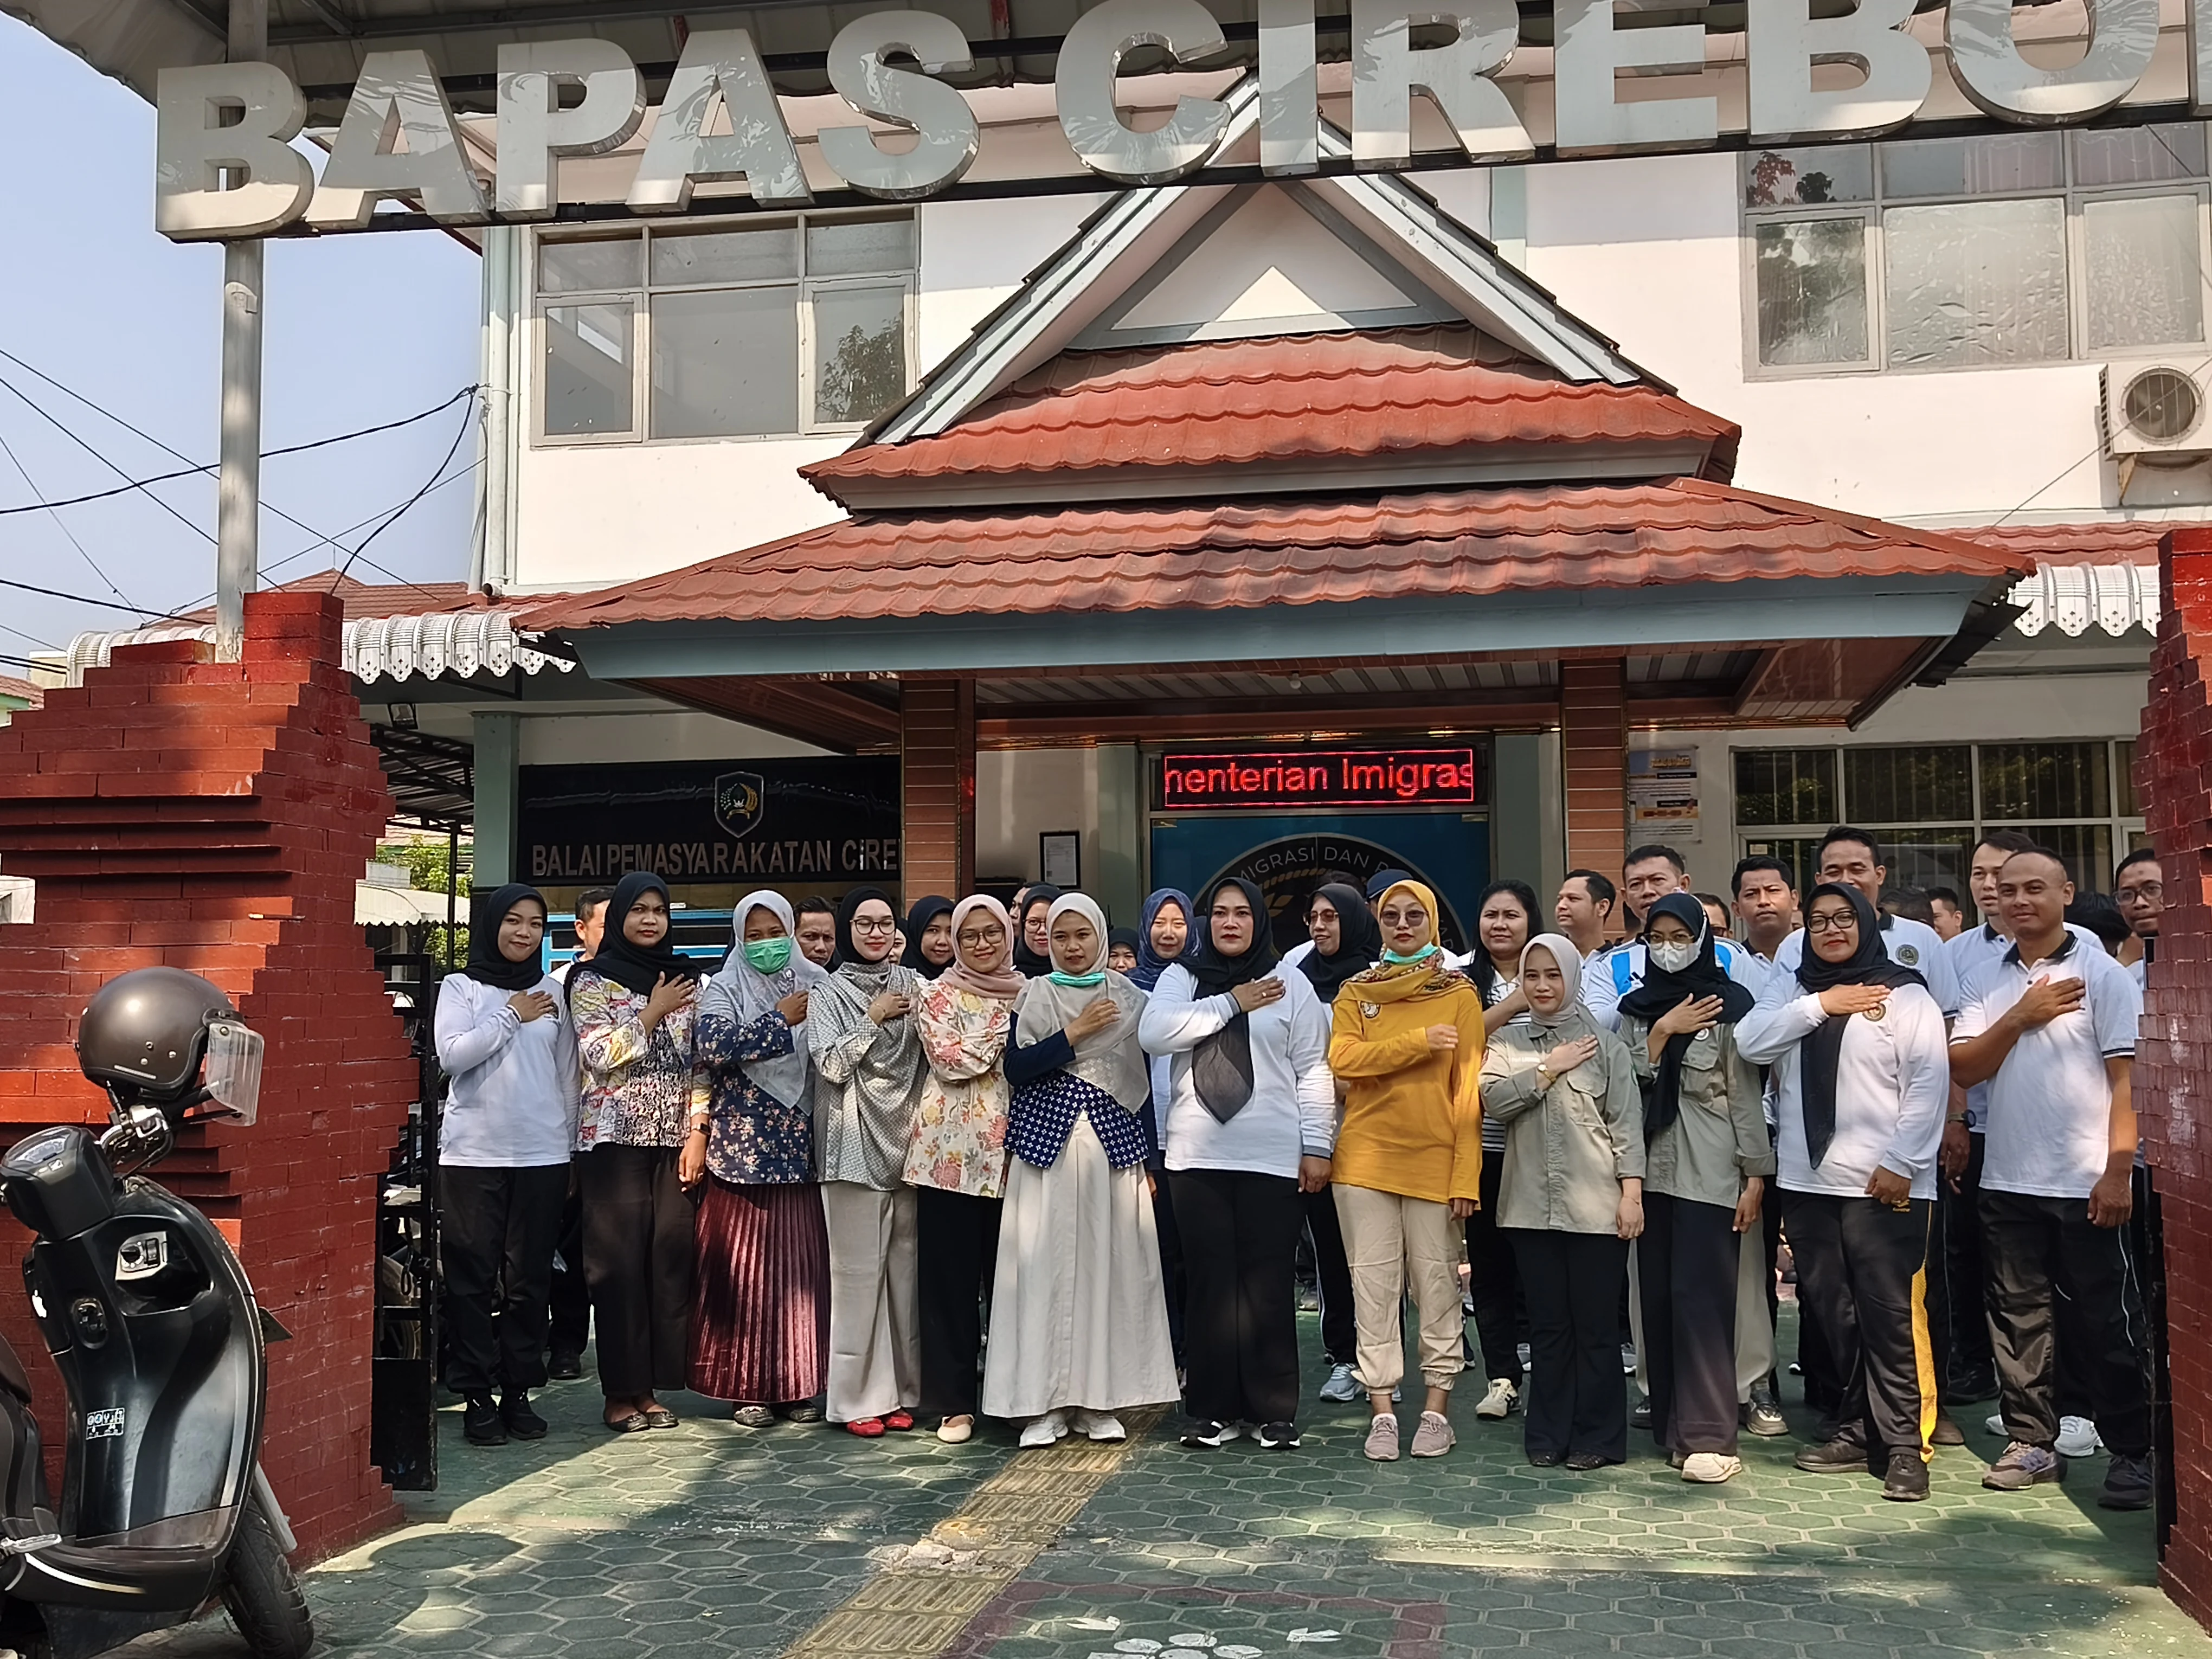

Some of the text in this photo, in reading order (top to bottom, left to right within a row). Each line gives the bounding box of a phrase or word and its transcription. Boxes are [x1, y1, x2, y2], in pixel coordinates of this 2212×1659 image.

[155, 0, 2212, 243] BAPAS CIREBO
[1343, 757, 1472, 796] Imigras
[532, 839, 901, 877] BALAI PEMASYARAKATAN CIRE
[1324, 847, 1369, 868] DAN
